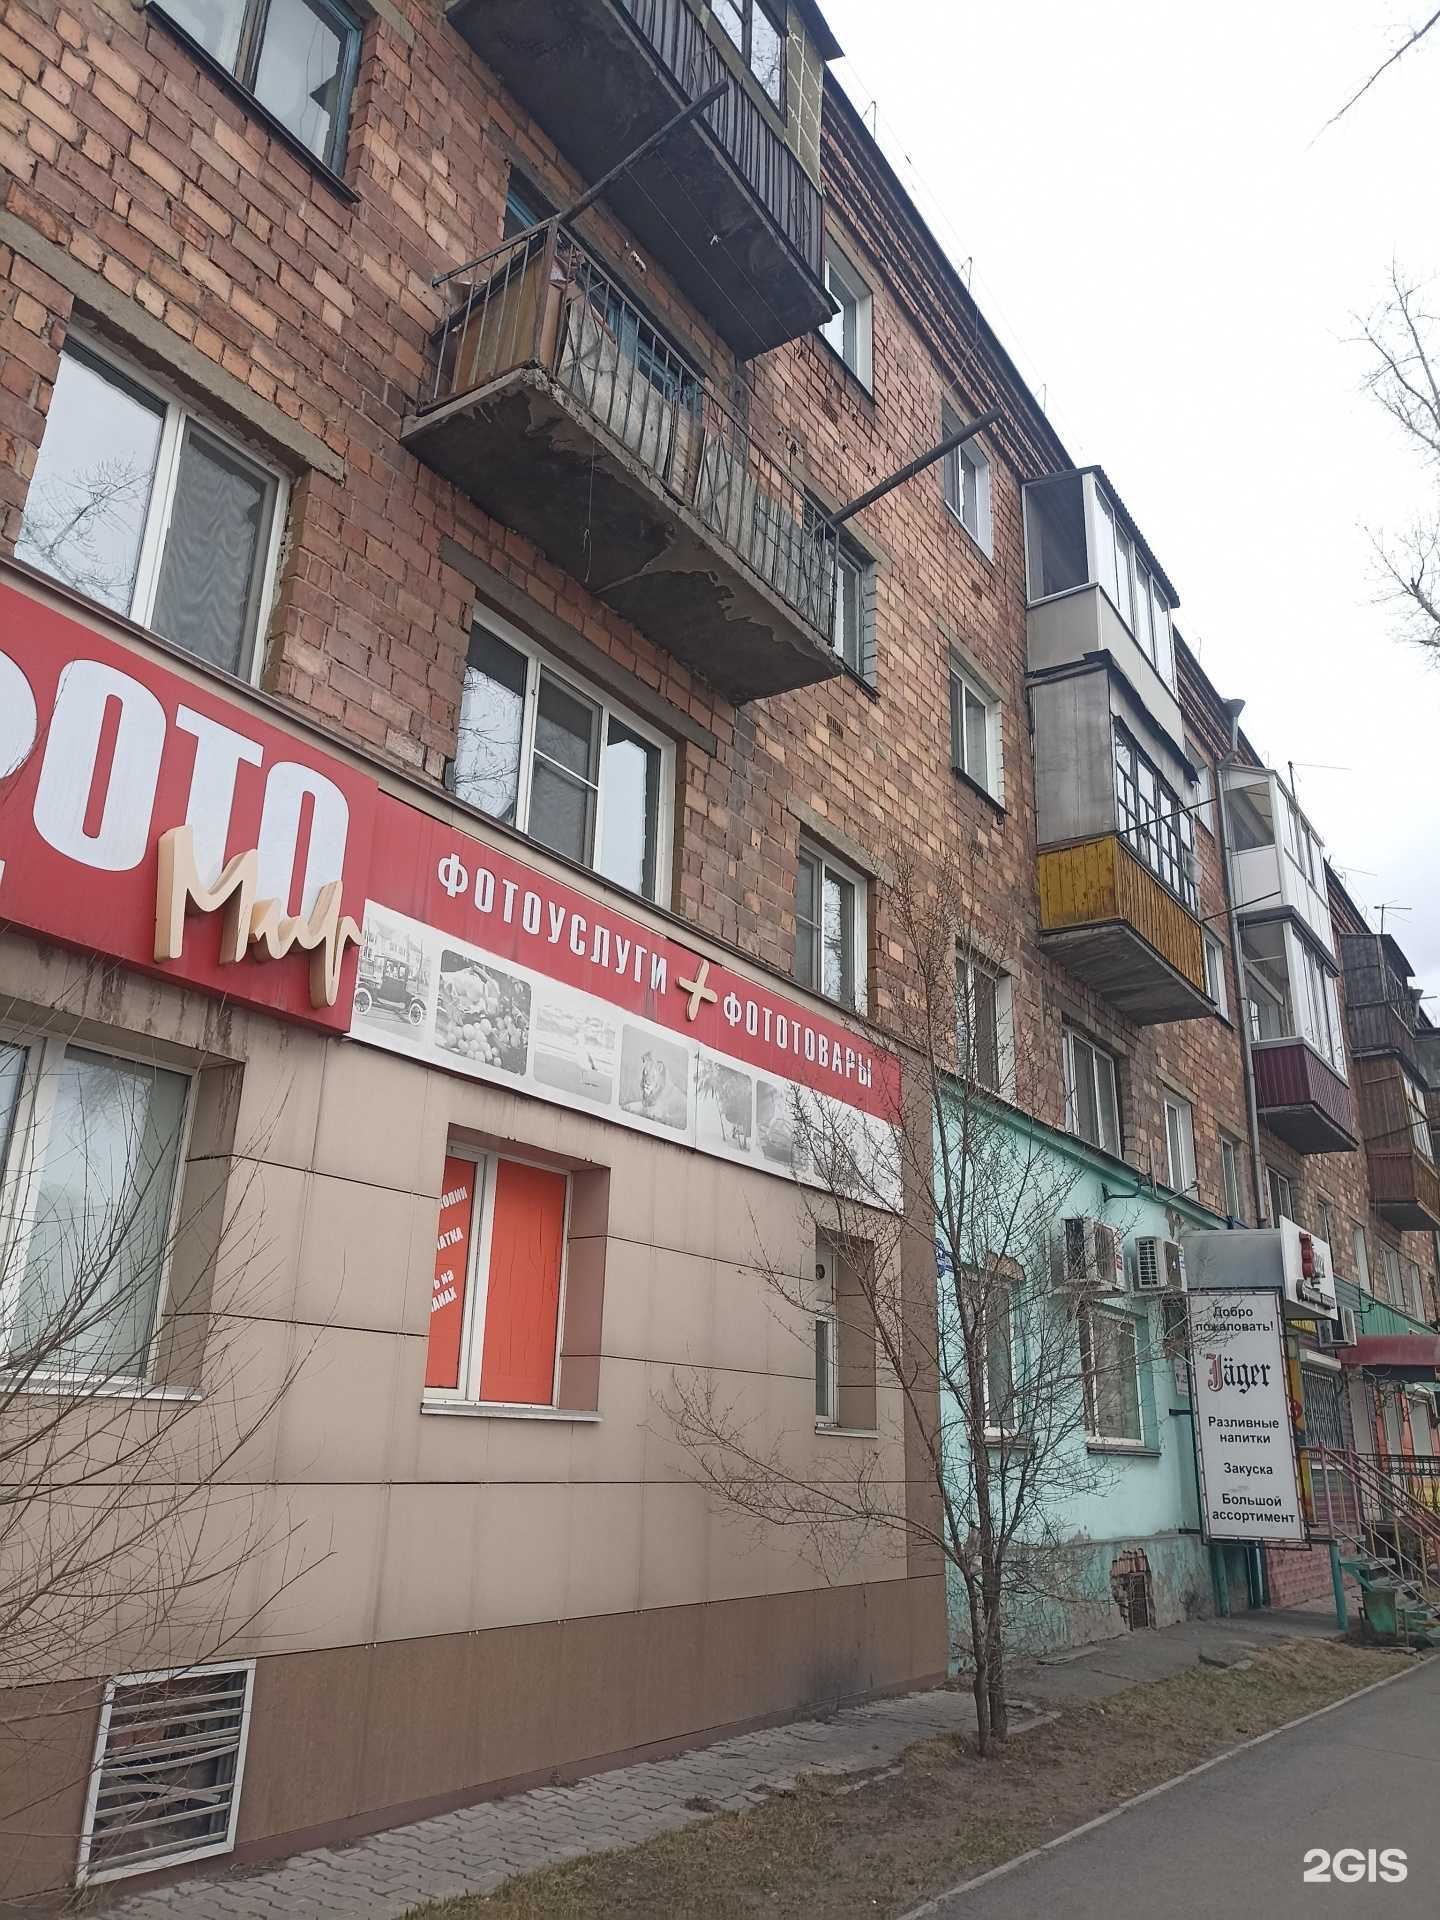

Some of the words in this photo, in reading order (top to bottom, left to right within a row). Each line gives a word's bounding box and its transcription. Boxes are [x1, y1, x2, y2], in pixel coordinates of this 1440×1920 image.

[438, 853, 667, 995] ФОТОУСЛУГИ
[723, 991, 872, 1088] ФОТОТОВАРЫ
[1213, 1306, 1253, 1318] Добро
[1196, 1321, 1274, 1332] пожаловать!
[1206, 1353, 1271, 1394] Jäger
[1208, 1416, 1280, 1429] Разливные
[1220, 1434, 1271, 1443] напитки
[1223, 1462, 1273, 1477] Закуска
[1222, 1493, 1282, 1507] Большой
[1212, 1510, 1296, 1523] ассортимент
